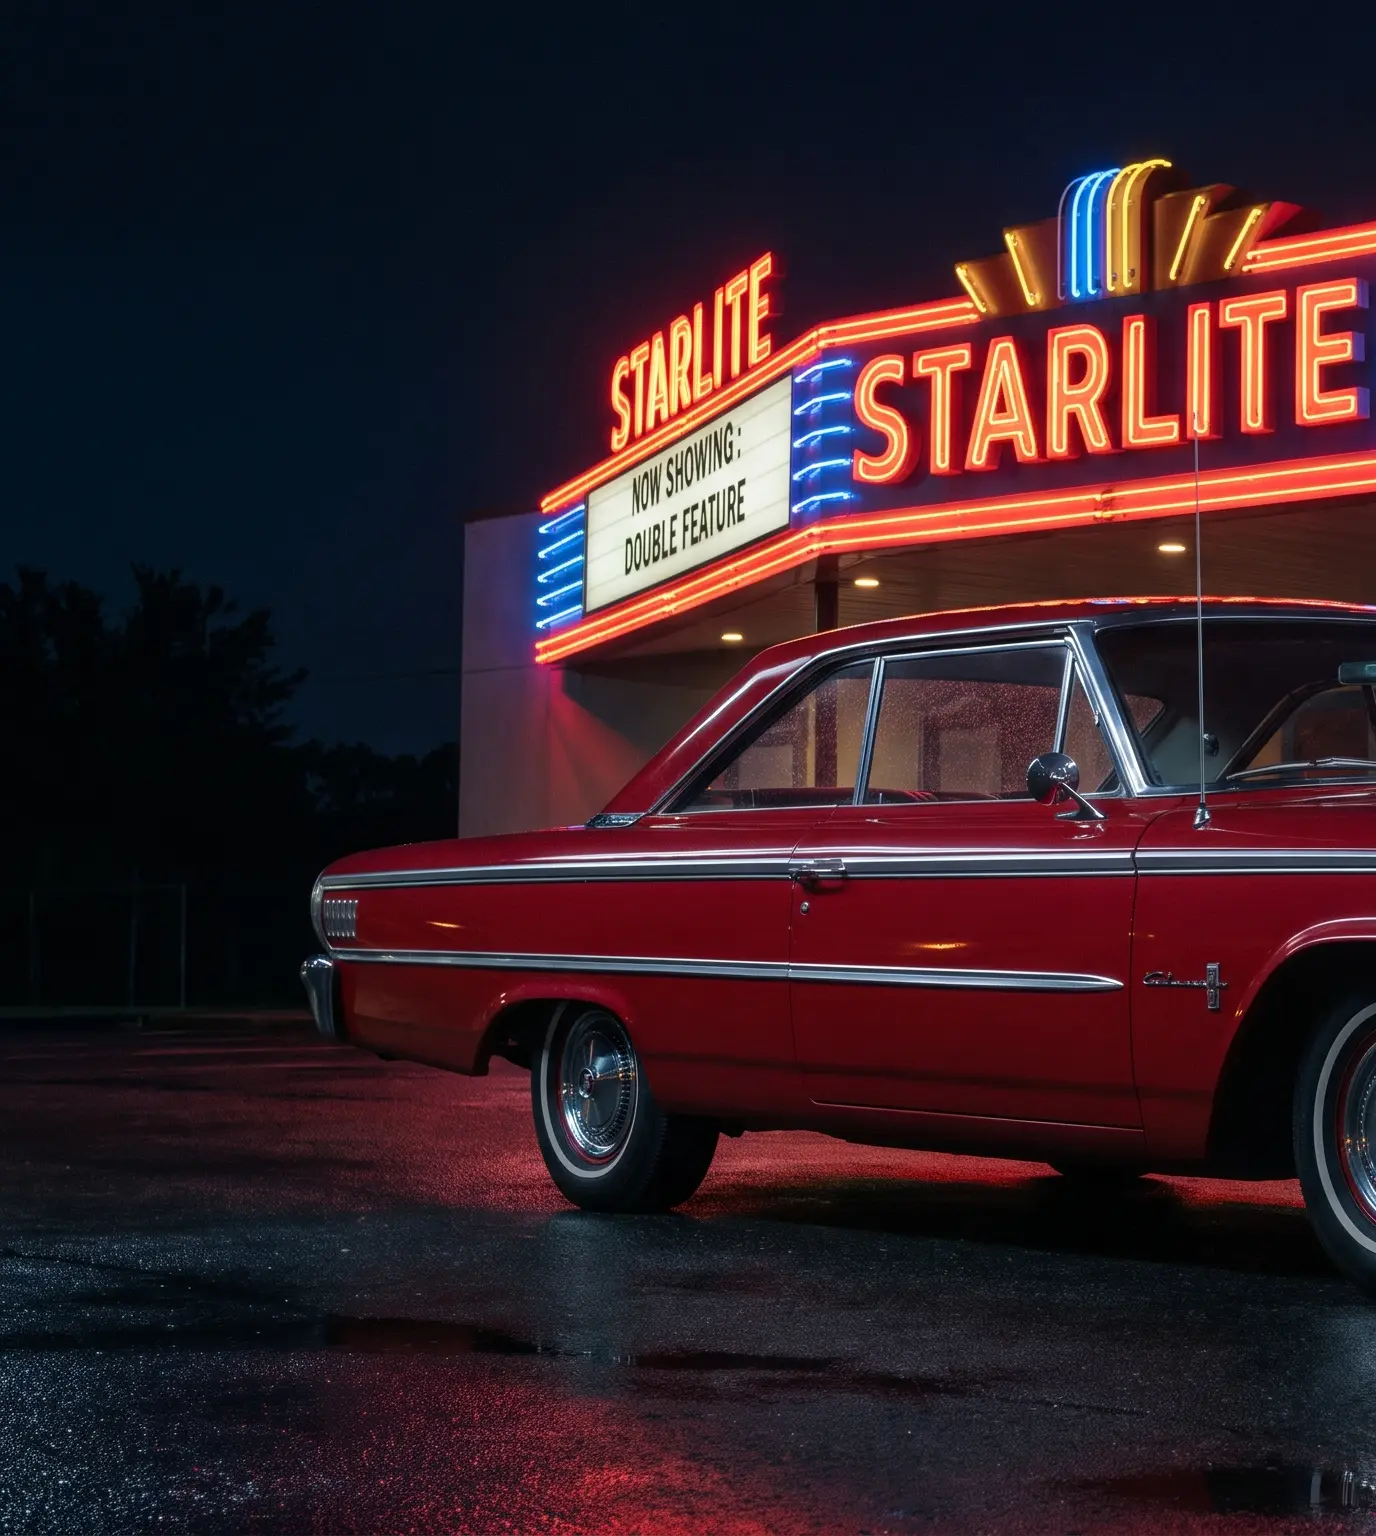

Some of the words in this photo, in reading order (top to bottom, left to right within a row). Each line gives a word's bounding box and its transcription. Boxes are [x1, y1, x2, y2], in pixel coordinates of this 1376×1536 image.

[611, 251, 772, 453] STARLITE
[852, 277, 1368, 484] STARLITE
[625, 514, 677, 576] DOUBLE
[682, 478, 746, 550] FEATURE
[632, 463, 662, 516] NOW
[665, 421, 741, 498] SHOWING:
